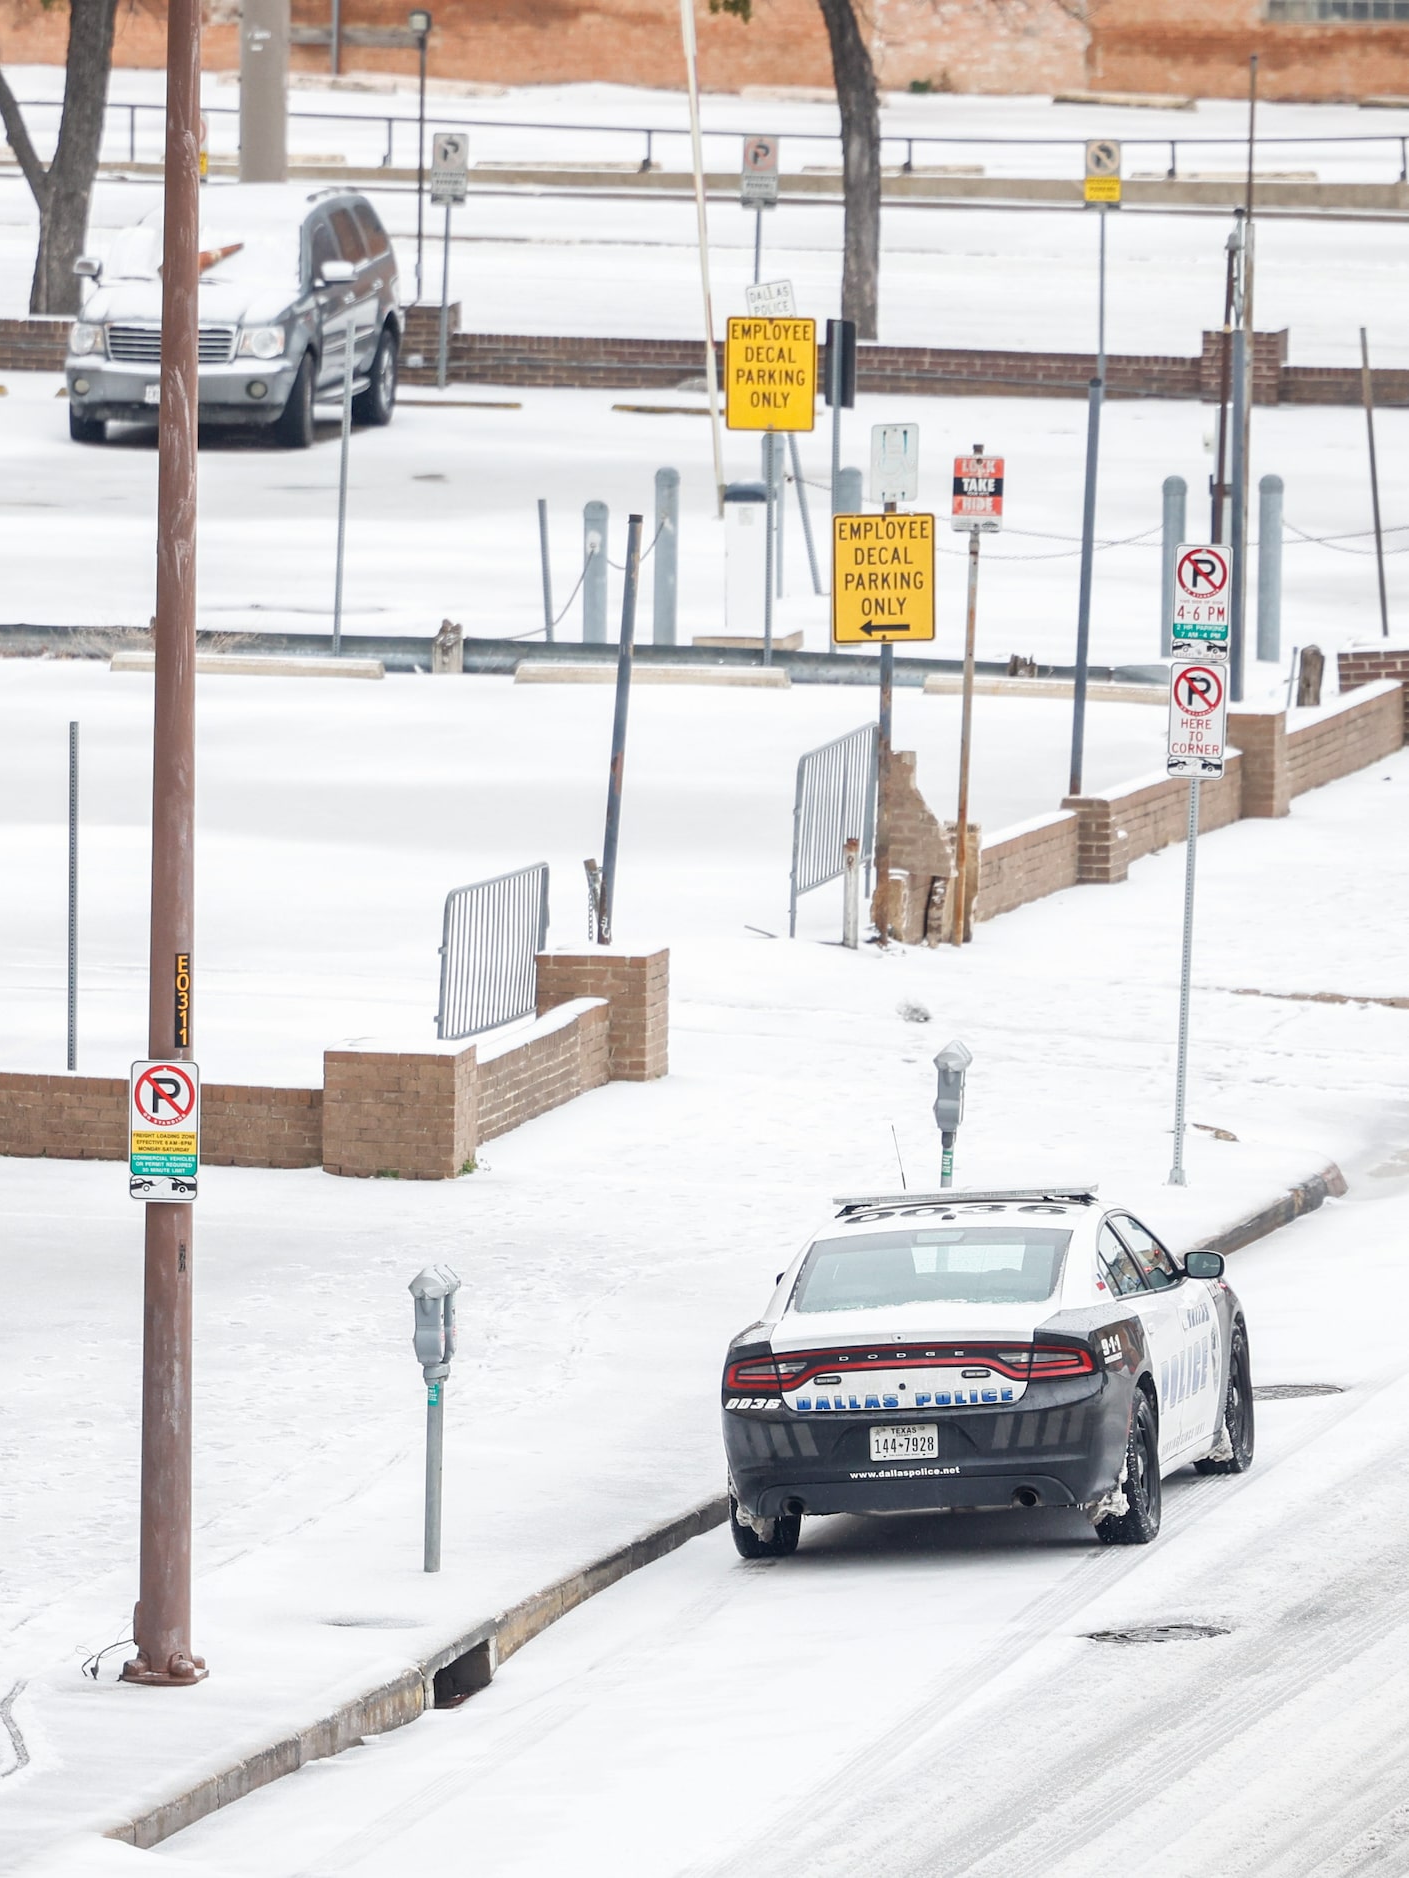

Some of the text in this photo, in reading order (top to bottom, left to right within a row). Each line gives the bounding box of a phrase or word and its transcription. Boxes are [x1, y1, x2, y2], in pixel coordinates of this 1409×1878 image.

[750, 287, 789, 303] DALLAS
[755, 302, 789, 316] POLICE
[732, 324, 811, 341] EMPLOYEE
[745, 347, 796, 363] DECAL
[736, 369, 805, 386] PARKING
[751, 392, 790, 408] ONLY
[962, 479, 995, 492] TAKE
[839, 521, 929, 540] EMPLOYEE
[854, 547, 913, 565] DECAL
[845, 571, 923, 591] PARKING
[861, 598, 906, 616] ONLY
[1177, 605, 1225, 621] 4-6 PM
[1181, 718, 1211, 729] HERE
[1189, 732, 1203, 742] TO
[1172, 743, 1219, 755] CORNER
[843, 1204, 1069, 1224] 0036
[839, 1350, 965, 1361] DODGE
[1160, 1335, 1208, 1416] POLICE
[725, 1398, 781, 1409] 0036
[796, 1387, 1014, 1410] DALLAS POLICE
[850, 1466, 960, 1479] www.dallaspolice.net
